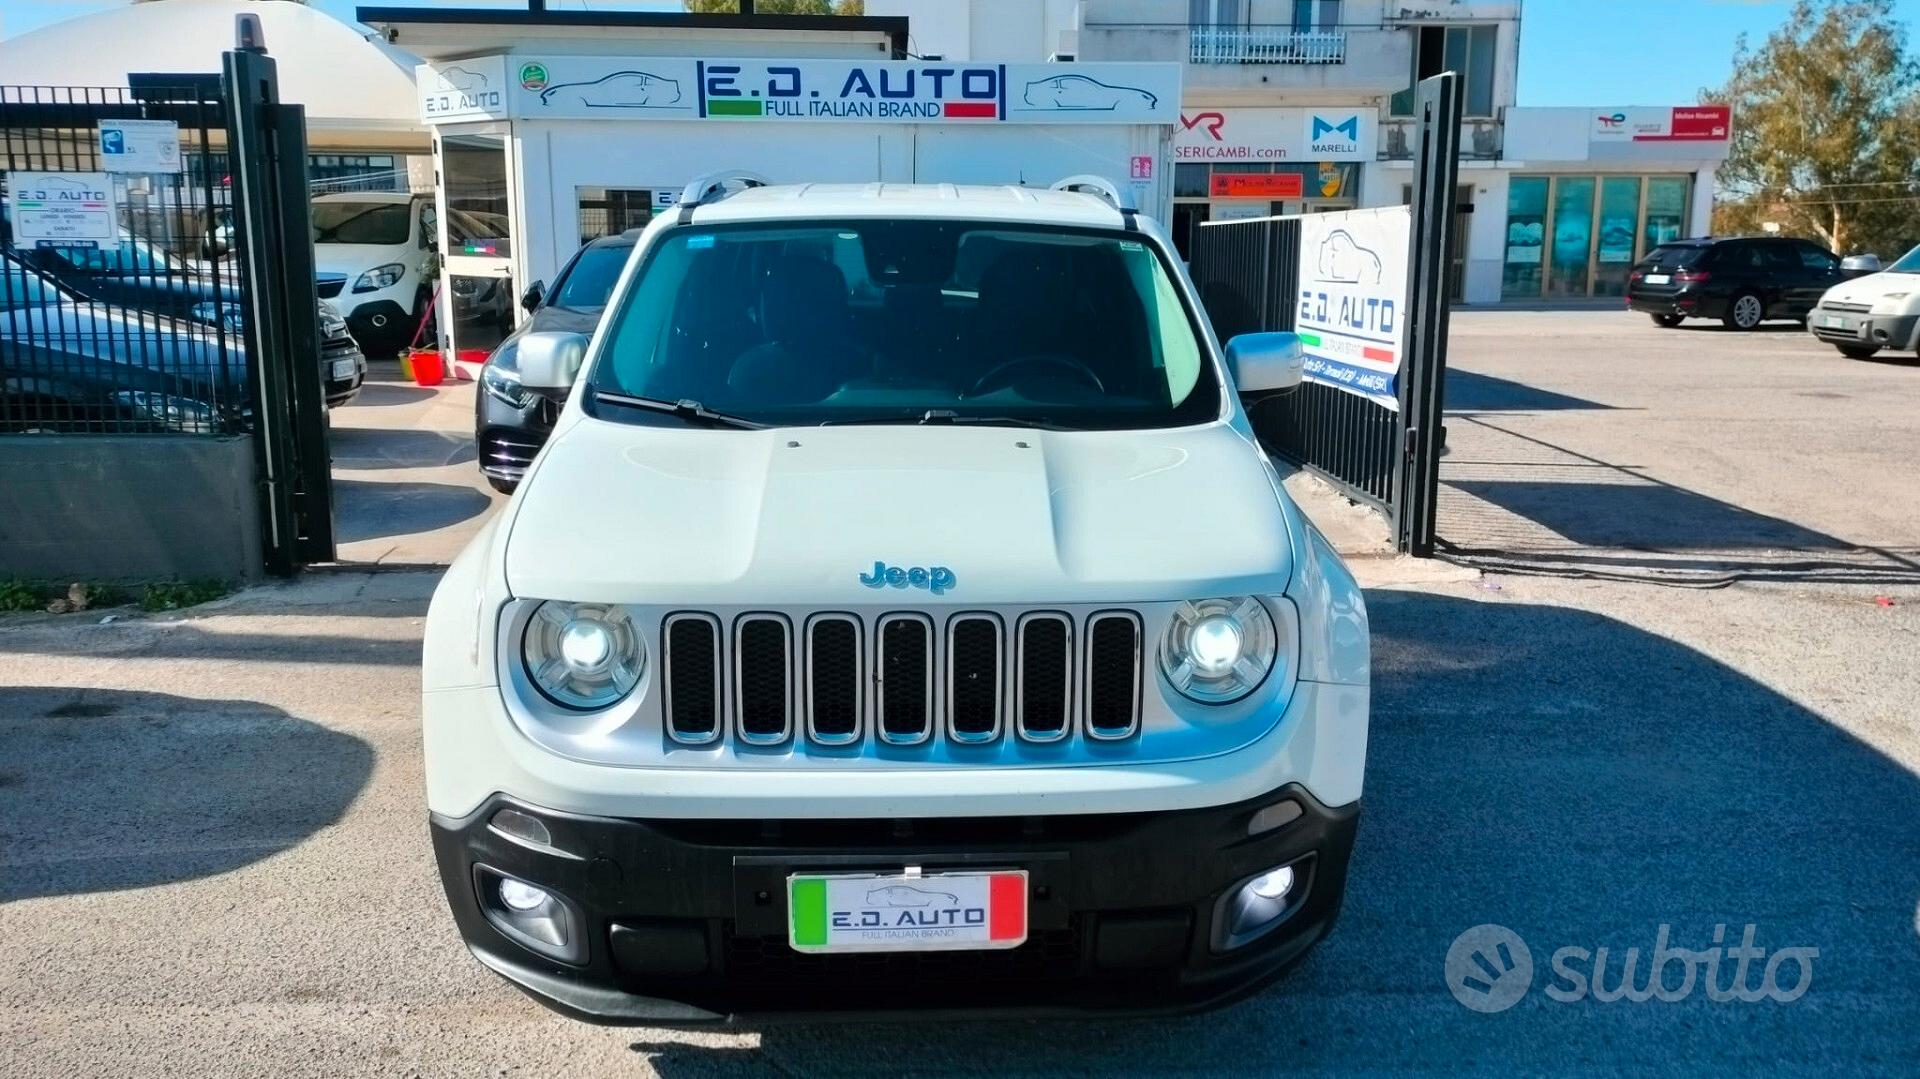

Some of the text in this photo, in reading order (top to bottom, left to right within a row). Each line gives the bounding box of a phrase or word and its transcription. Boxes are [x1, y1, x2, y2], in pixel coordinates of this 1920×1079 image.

[707, 66, 996, 99] E.D. AUTO
[426, 91, 499, 112] E.D. AUTO
[765, 101, 941, 117] FULL ITALIAN BRAND
[1312, 145, 1356, 153] MARELLI
[18, 190, 105, 200] E.D. AUTO
[1301, 291, 1394, 333] E.D. AUTO
[859, 561, 957, 595] Jeep
[832, 908, 984, 927] E.D. AUTO
[862, 930, 954, 939] FULL ITALIAN BRAND
